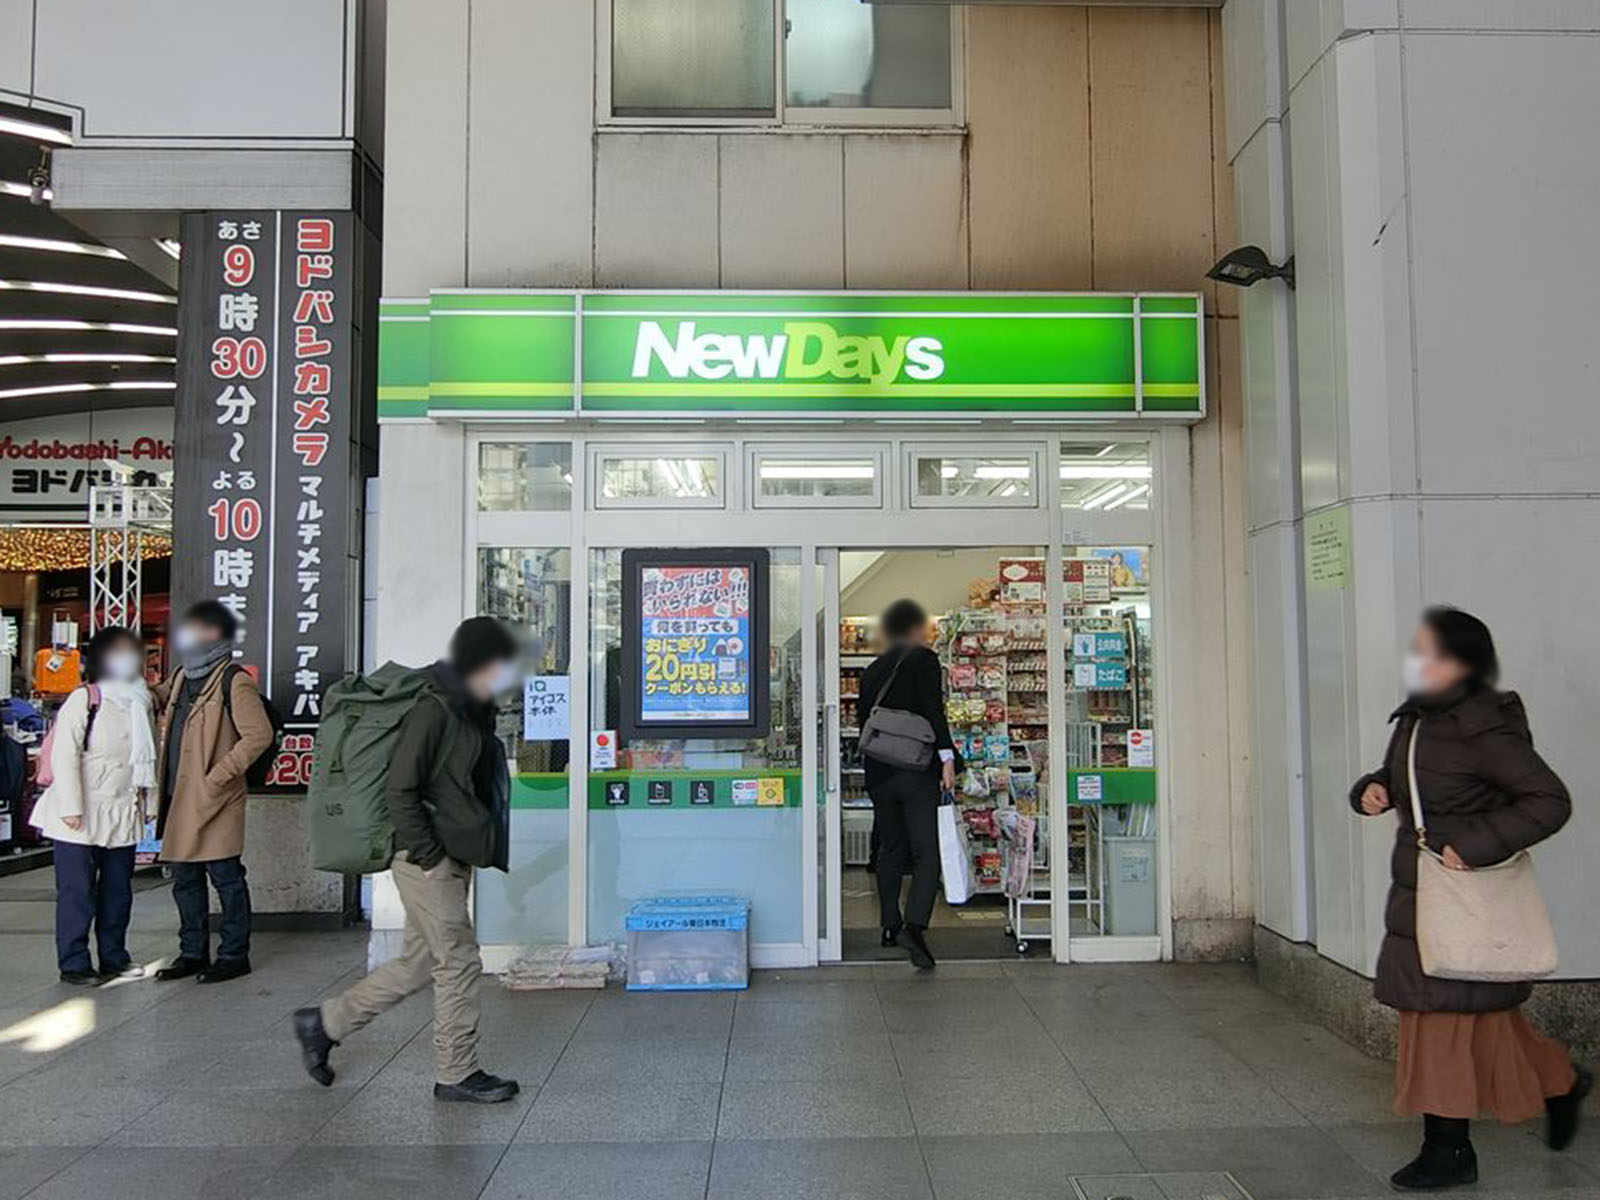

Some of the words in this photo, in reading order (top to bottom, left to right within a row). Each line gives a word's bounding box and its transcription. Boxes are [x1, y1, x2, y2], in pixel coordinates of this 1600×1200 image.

[293, 218, 334, 466] ヨドバシカメラ
[631, 320, 945, 385] NewDays
[296, 475, 323, 634] マルチメディア
[294, 645, 321, 716] アキバ
[645, 636, 707, 654] おにぎり
